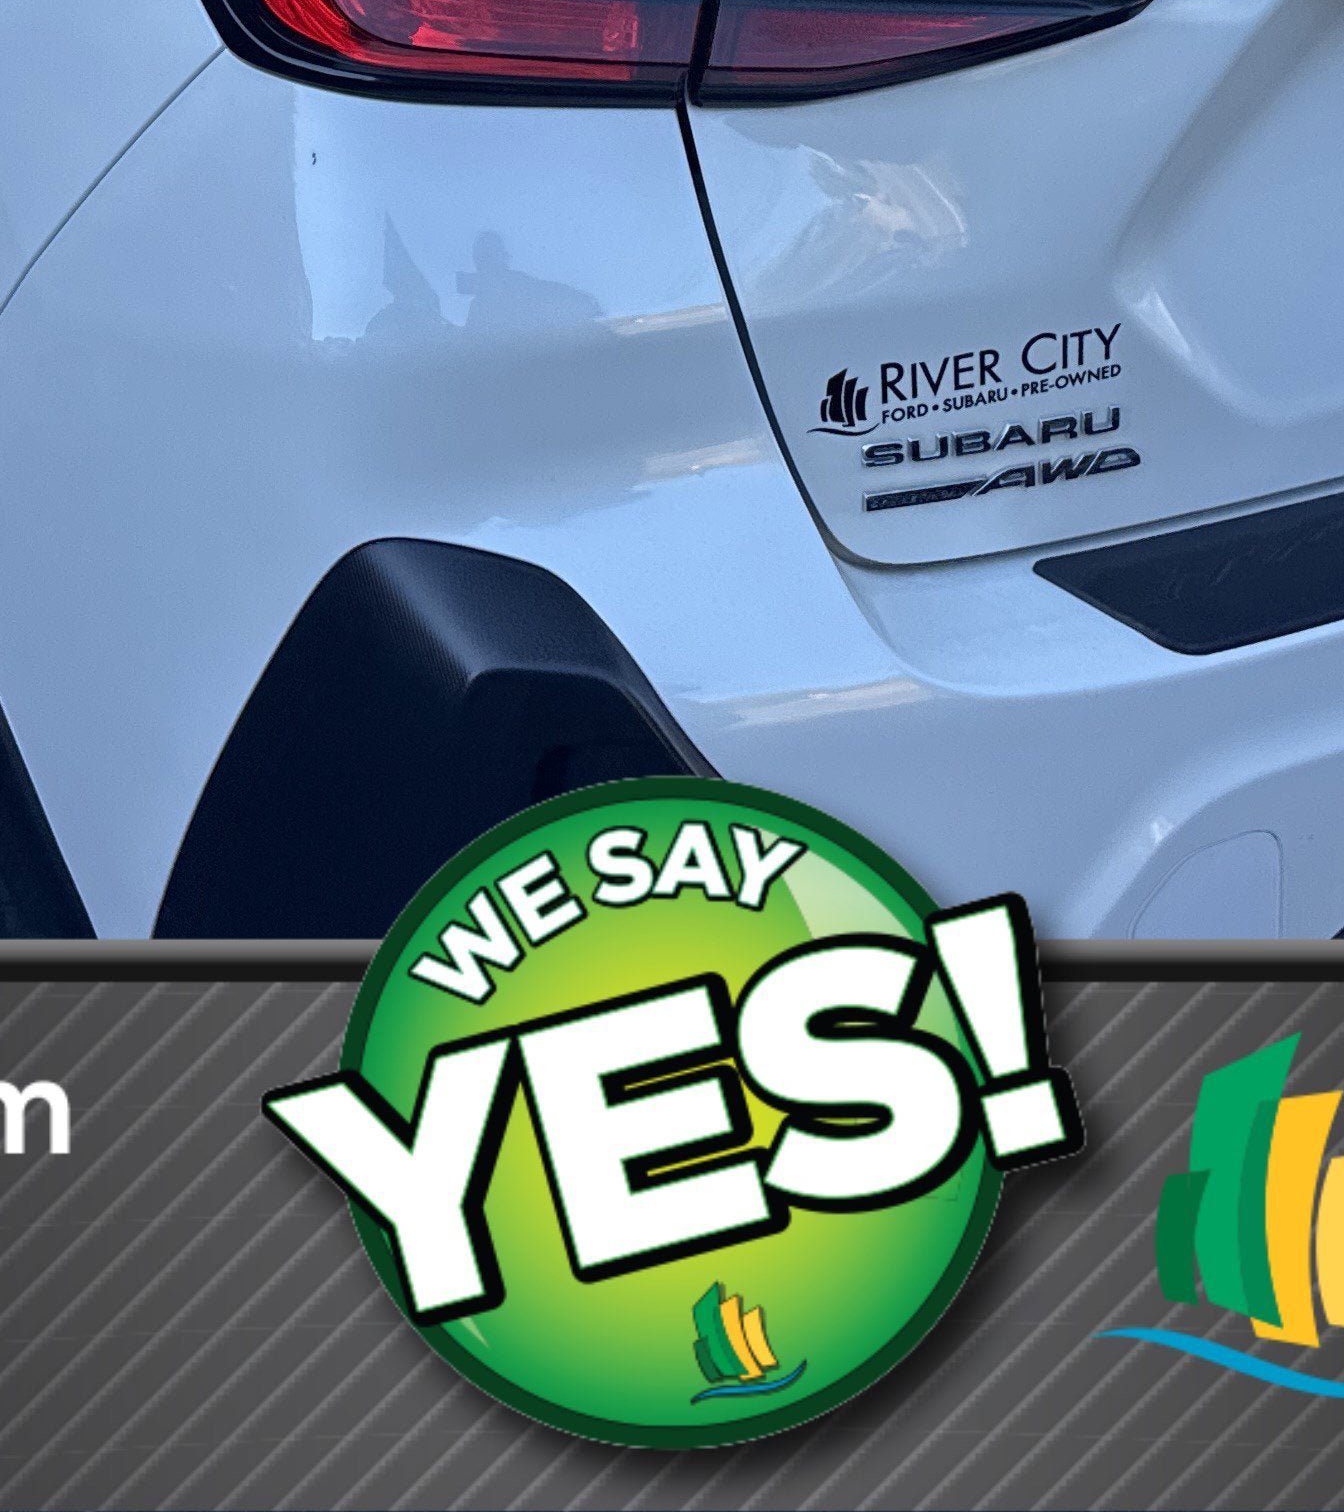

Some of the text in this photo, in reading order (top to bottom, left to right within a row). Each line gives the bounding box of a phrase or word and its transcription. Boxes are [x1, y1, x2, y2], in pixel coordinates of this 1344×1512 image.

[879, 322, 1123, 405] RIVER CITY
[881, 363, 1123, 425] FORD SUBARU PRE-OWNED
[861, 405, 1122, 468] SUBARU
[968, 445, 1143, 498] AWD
